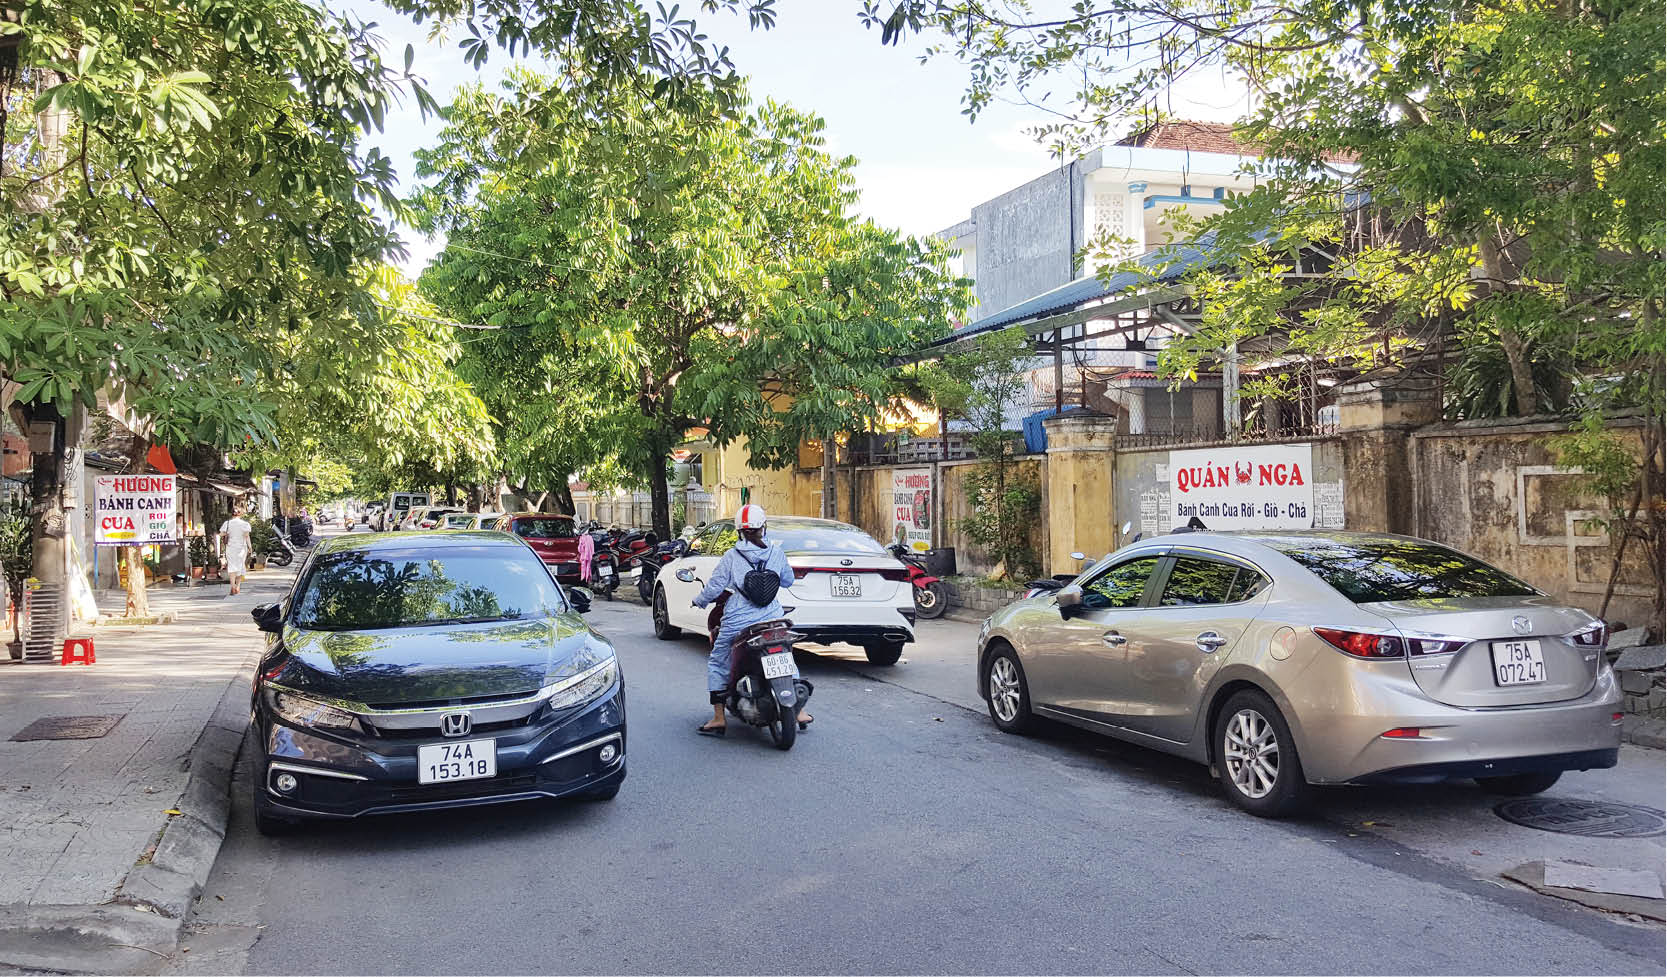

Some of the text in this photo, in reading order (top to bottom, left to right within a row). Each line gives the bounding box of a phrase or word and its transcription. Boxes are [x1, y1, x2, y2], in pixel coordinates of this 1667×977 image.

[113, 476, 173, 493] HƯƠNG
[1177, 461, 1230, 493] QUÁN
[1258, 463, 1305, 486] NGA
[99, 494, 172, 510] BÁNH CANH
[1178, 502, 1197, 517] Bánh
[1200, 502, 1220, 517] Canh
[1222, 502, 1238, 517] Cua
[1264, 502, 1278, 518] Giò
[1288, 501, 1306, 518] Chả
[896, 507, 911, 521] CUA
[101, 516, 135, 530] CUA
[838, 576, 854, 586] 75A
[1505, 642, 1532, 661] 75A
[1500, 662, 1543, 682] 072.47
[441, 744, 473, 761] 74A
[430, 759, 487, 780] 153.18
